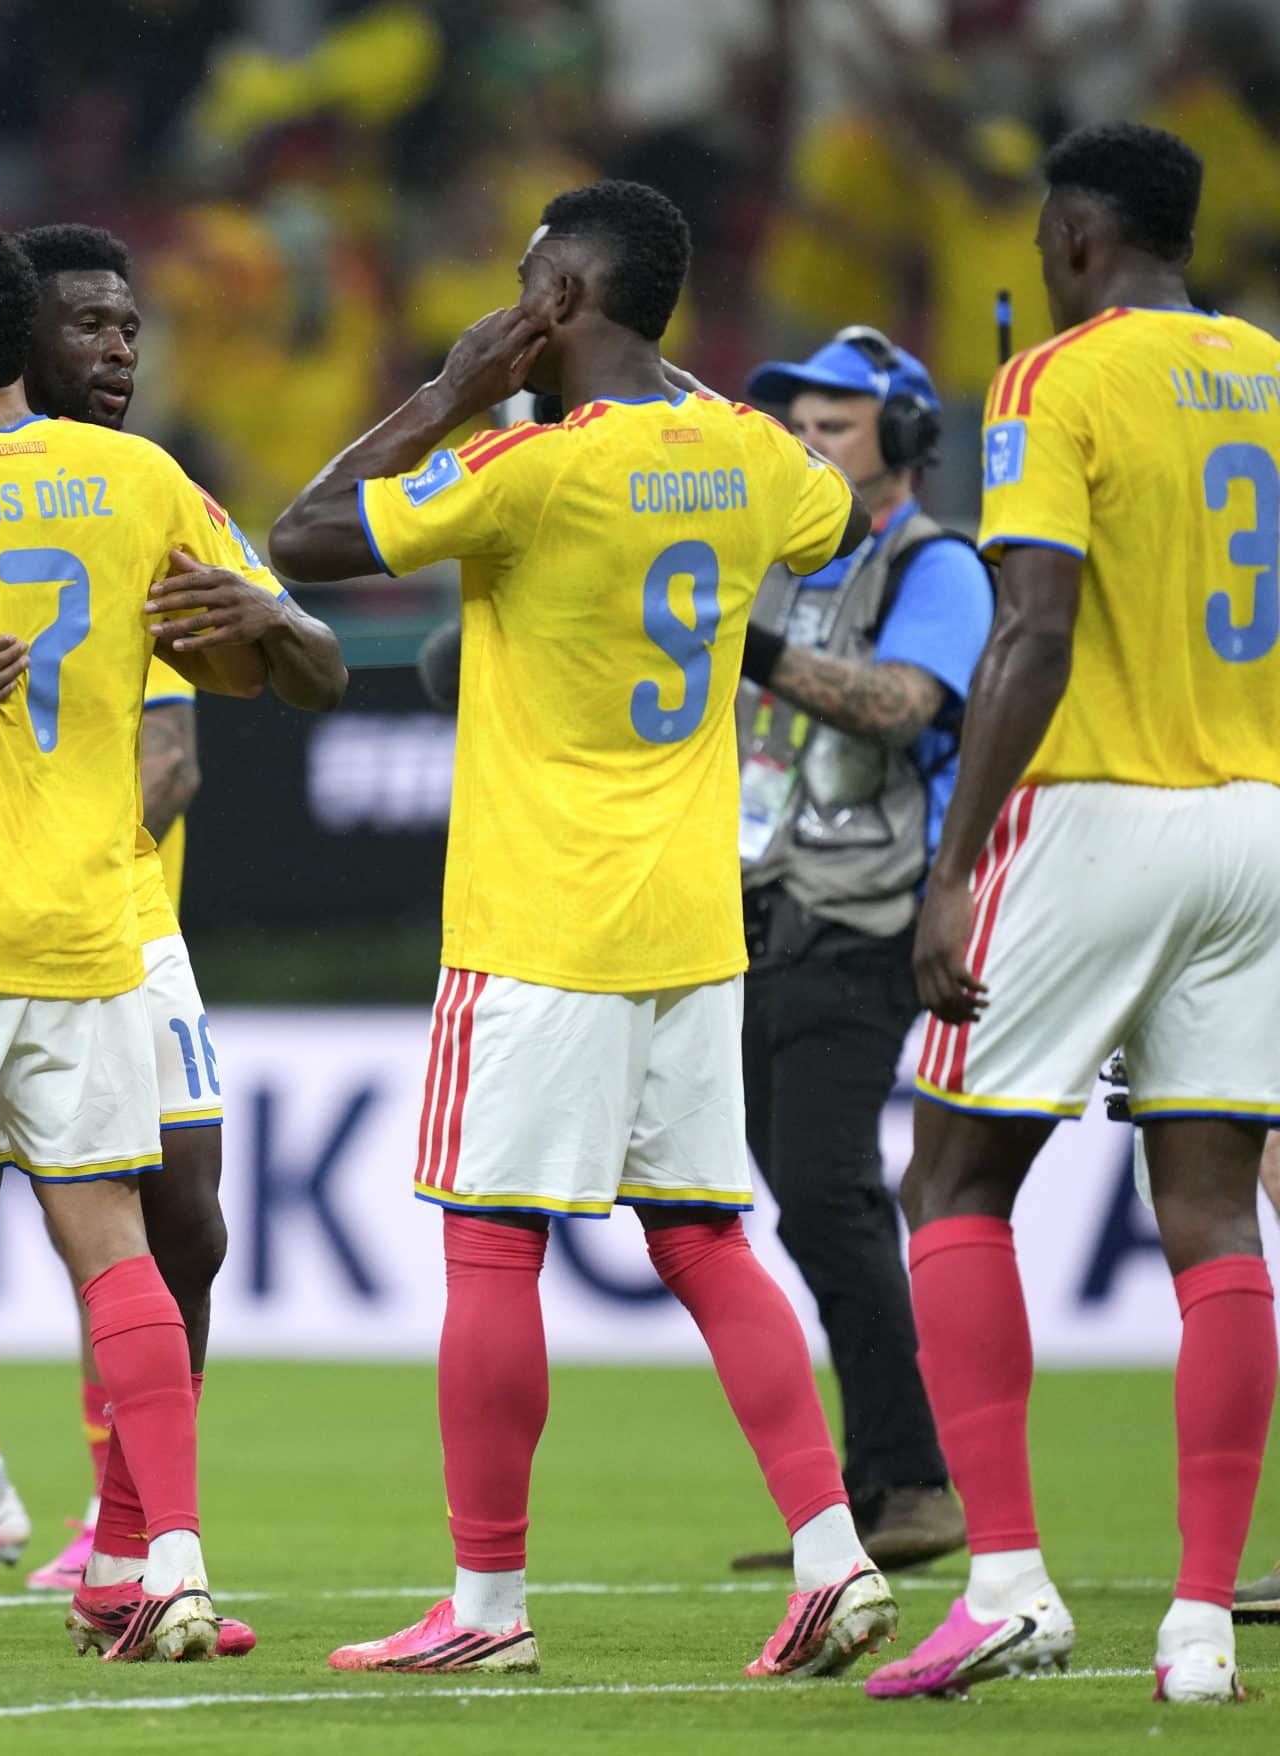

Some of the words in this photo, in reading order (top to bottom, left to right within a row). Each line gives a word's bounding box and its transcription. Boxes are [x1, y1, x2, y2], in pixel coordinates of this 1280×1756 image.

[1171, 366, 1280, 412] J.LUCUM
[35, 468, 113, 519] DÍAZ
[630, 468, 747, 513] CORDOBA
[1203, 442, 1280, 663] 3
[630, 540, 721, 743] 9
